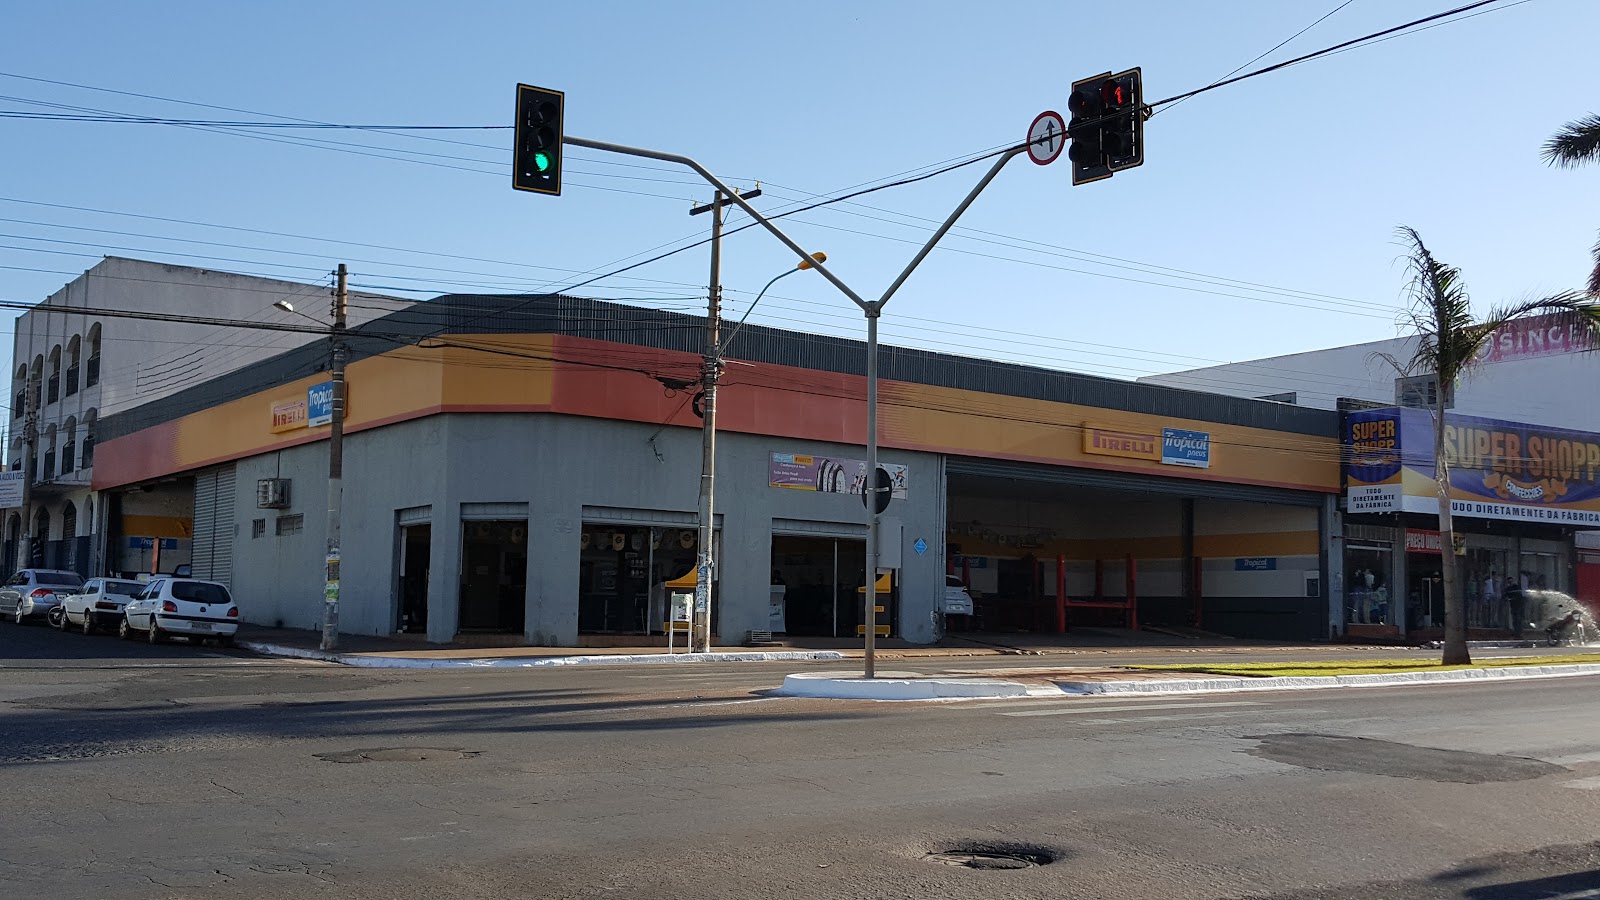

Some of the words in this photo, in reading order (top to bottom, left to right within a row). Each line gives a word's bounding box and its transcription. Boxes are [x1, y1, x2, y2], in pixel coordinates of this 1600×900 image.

[309, 385, 333, 410] Tropica
[1352, 419, 1395, 441] SUPER
[1093, 428, 1155, 454] PIRELLI
[1164, 431, 1208, 452] Tropical
[1186, 449, 1206, 458] pneus
[1443, 424, 1522, 474] SUPER
[1528, 436, 1600, 482] SHOPP
[1353, 494, 1395, 502] DIRETAMENTE
[1452, 502, 1472, 512] UDO
[1476, 504, 1544, 519] DIRETAMENTE
[1547, 510, 1559, 519] DA
